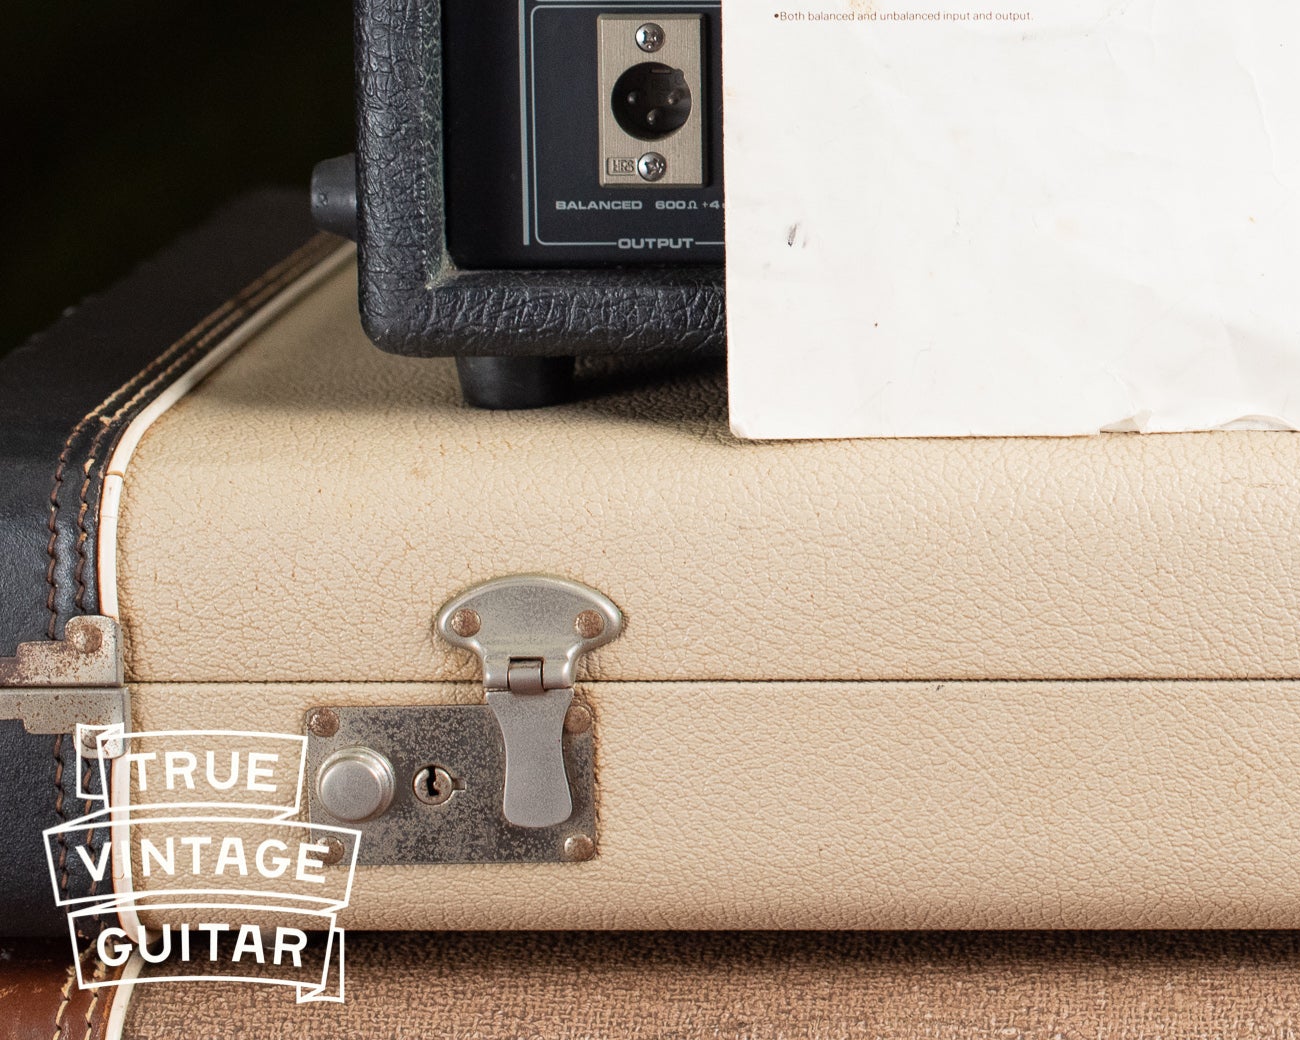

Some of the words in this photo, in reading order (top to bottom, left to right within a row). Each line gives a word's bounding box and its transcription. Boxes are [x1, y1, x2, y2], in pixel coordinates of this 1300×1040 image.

[779, 10, 806, 21] Both
[807, 10, 856, 21] balanced
[857, 10, 877, 21] and
[879, 10, 941, 21] unbalanced
[942, 10, 971, 24] input
[972, 10, 993, 21] and
[994, 10, 1034, 24] output.
[555, 200, 643, 210] BALANCED
[617, 237, 694, 249] OUTPUT
